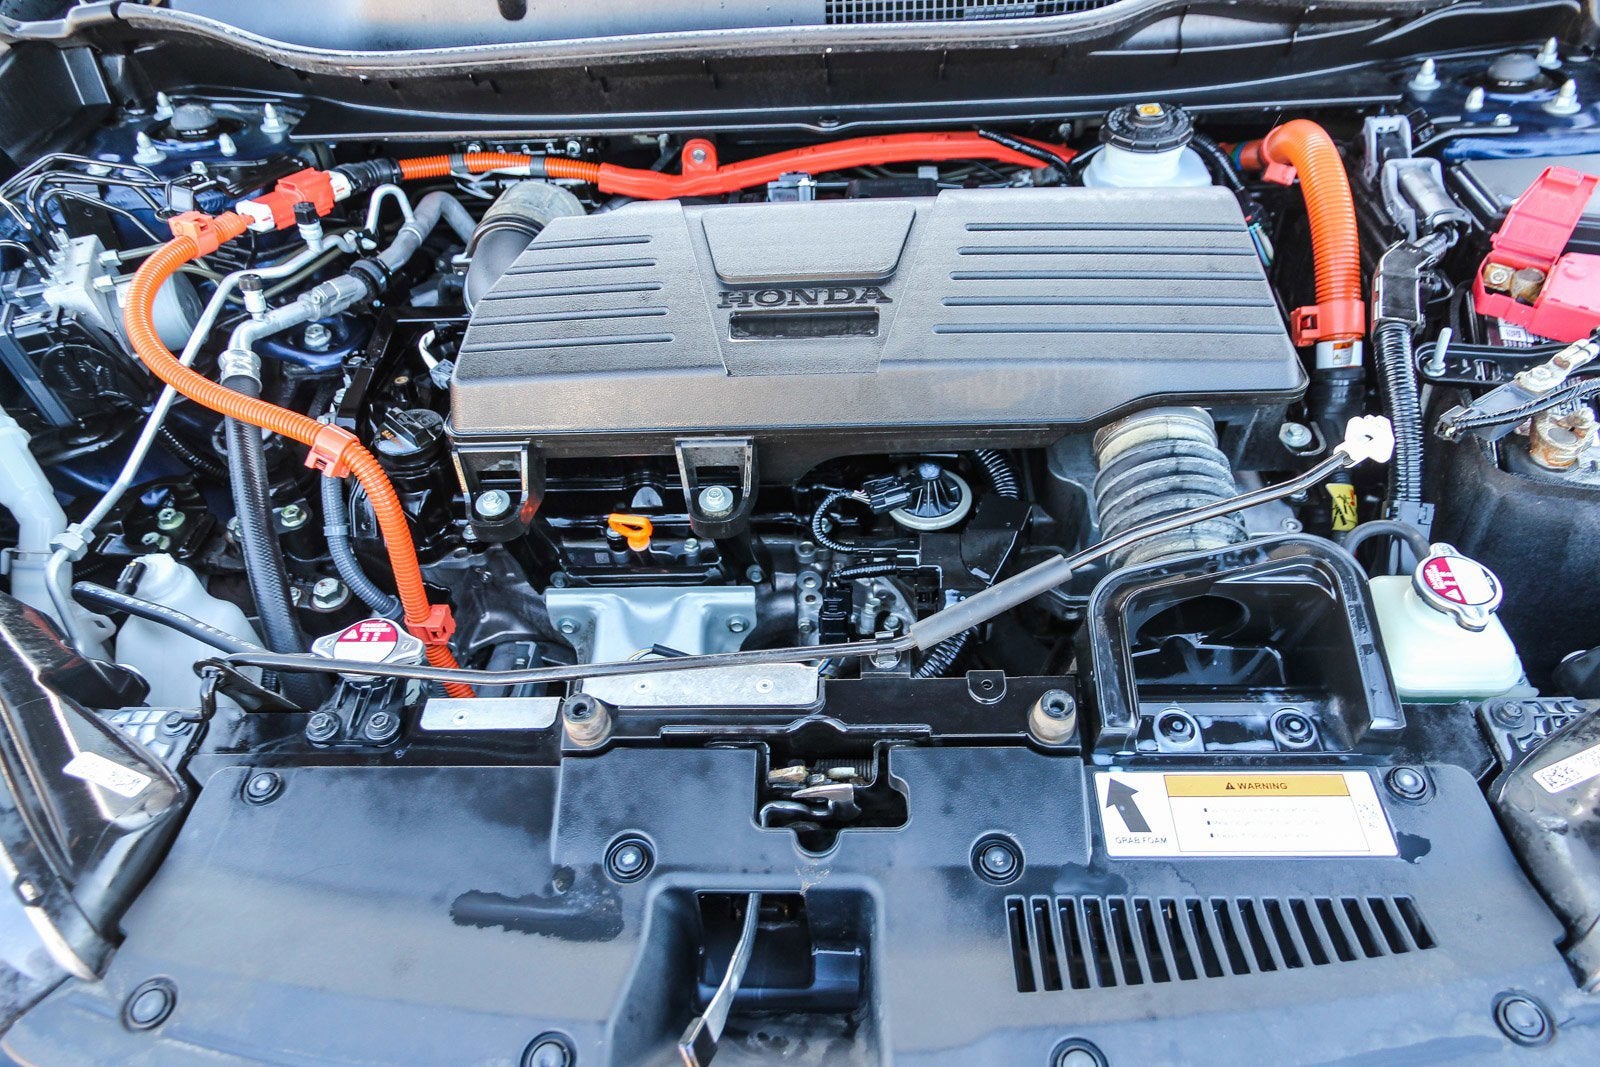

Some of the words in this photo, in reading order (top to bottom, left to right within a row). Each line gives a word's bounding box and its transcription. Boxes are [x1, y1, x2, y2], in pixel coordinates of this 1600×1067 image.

[717, 287, 893, 308] HONDA
[1237, 782, 1288, 790] WARNING
[1115, 836, 1141, 844] GRAB
[1142, 836, 1167, 844] FOAM
